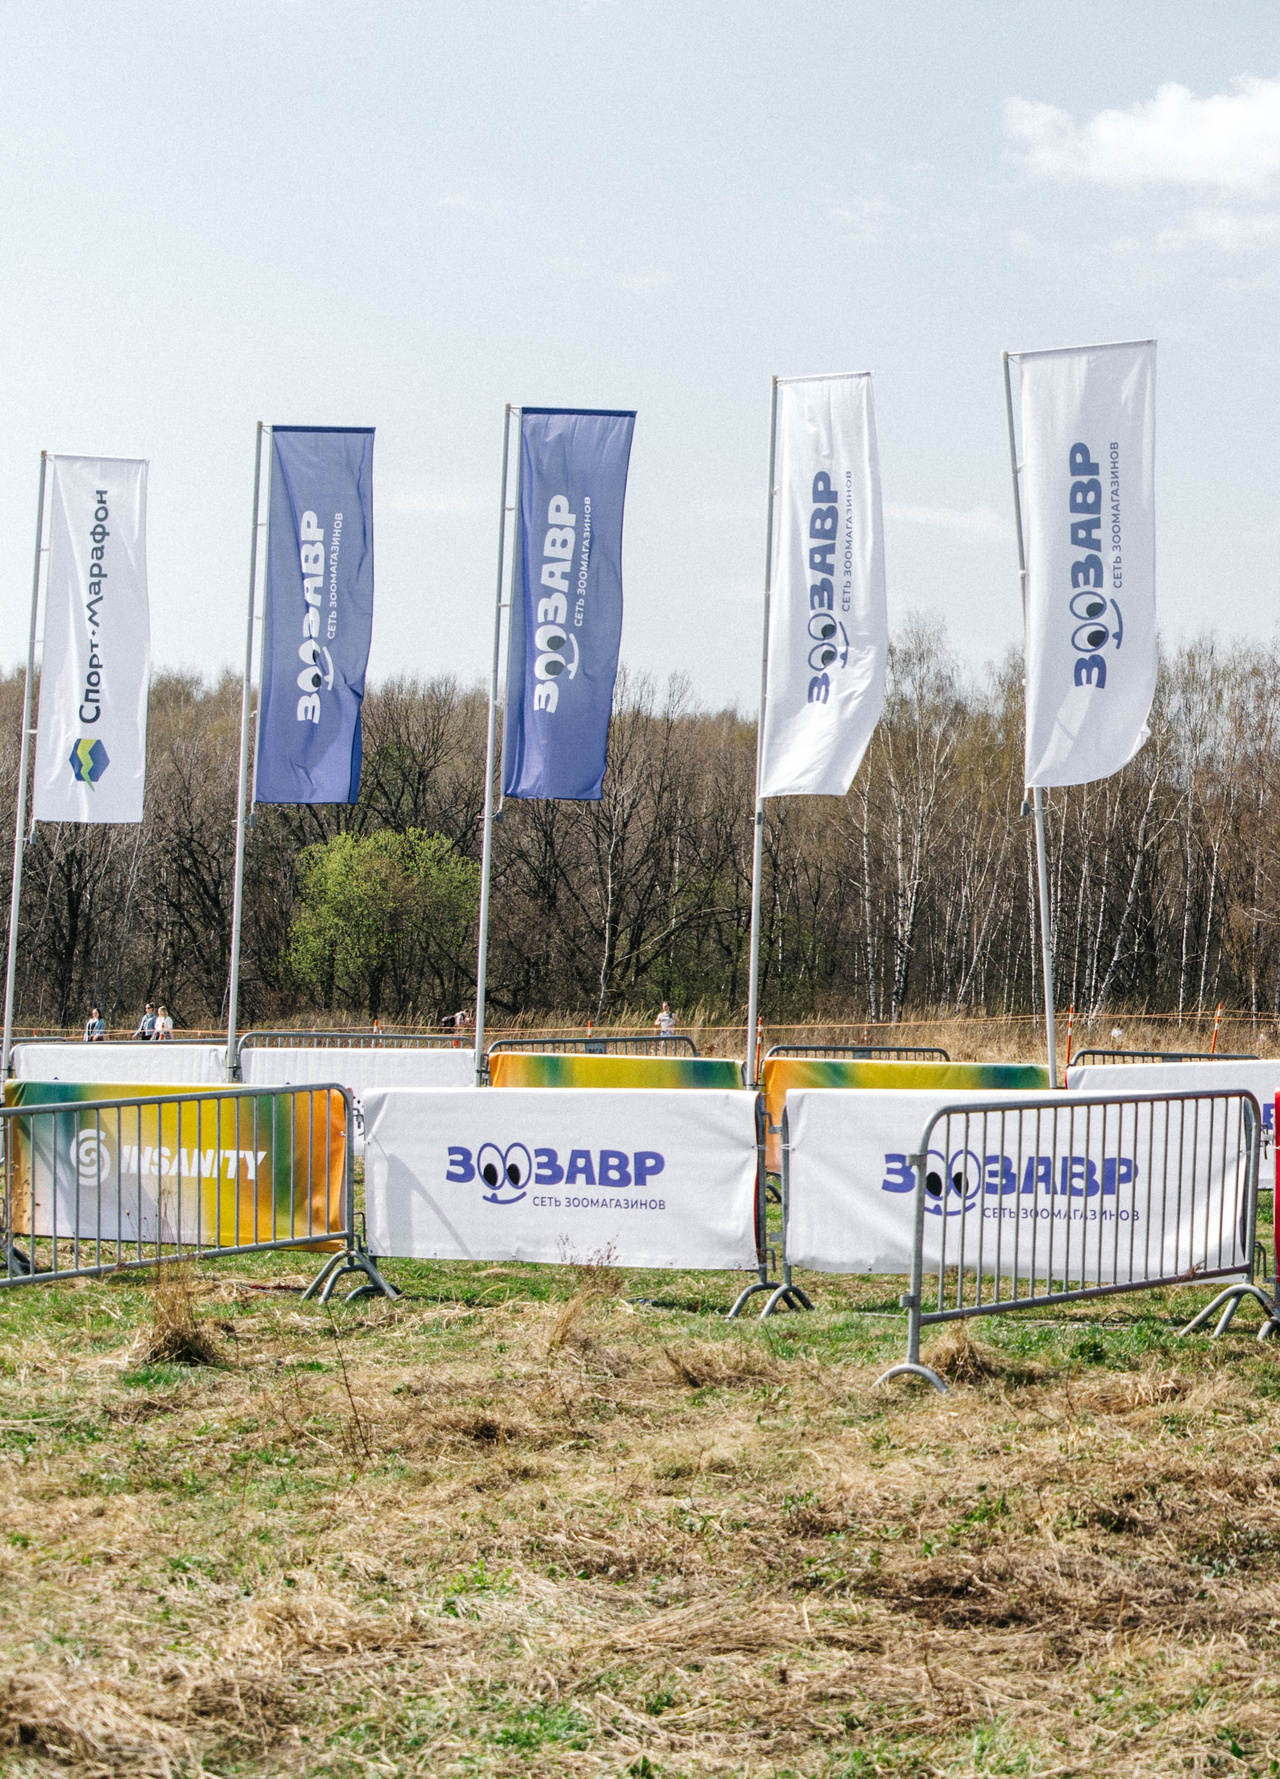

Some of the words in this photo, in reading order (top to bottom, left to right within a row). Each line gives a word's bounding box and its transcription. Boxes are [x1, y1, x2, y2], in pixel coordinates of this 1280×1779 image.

[1110, 441, 1122, 552] ЗООМАГАЗИНОВ
[577, 496, 591, 596] ЗООМАГАЗИНОВ
[843, 470, 853, 577] ЗООМАГАЗИНОВ
[329, 511, 344, 608] ЗООМАГАЗИНОВ
[1069, 442, 1110, 689] ЗООЗАВР
[1112, 556, 1122, 589] СЕТЬ
[533, 494, 577, 714] ЗООЗАВР
[574, 598, 585, 627] СЕТЬ
[807, 470, 839, 704] ЗООЗАВР
[841, 581, 852, 612] СЕТЬ
[297, 510, 325, 724] ЗООЗАВР
[327, 609, 338, 640] СЕТЬ
[120, 1145, 267, 1179] INSANITY
[445, 1142, 665, 1190] ЗООЗАВР
[881, 1149, 1139, 1201] ЗООЗАВР
[532, 1196, 562, 1207] СЕТЬ
[565, 1197, 666, 1210] ЗООМАГАЗИНОВ
[982, 1207, 1016, 1219] СЕТЬ
[1021, 1207, 1140, 1221] ЗООМАГАЗИНОВ
